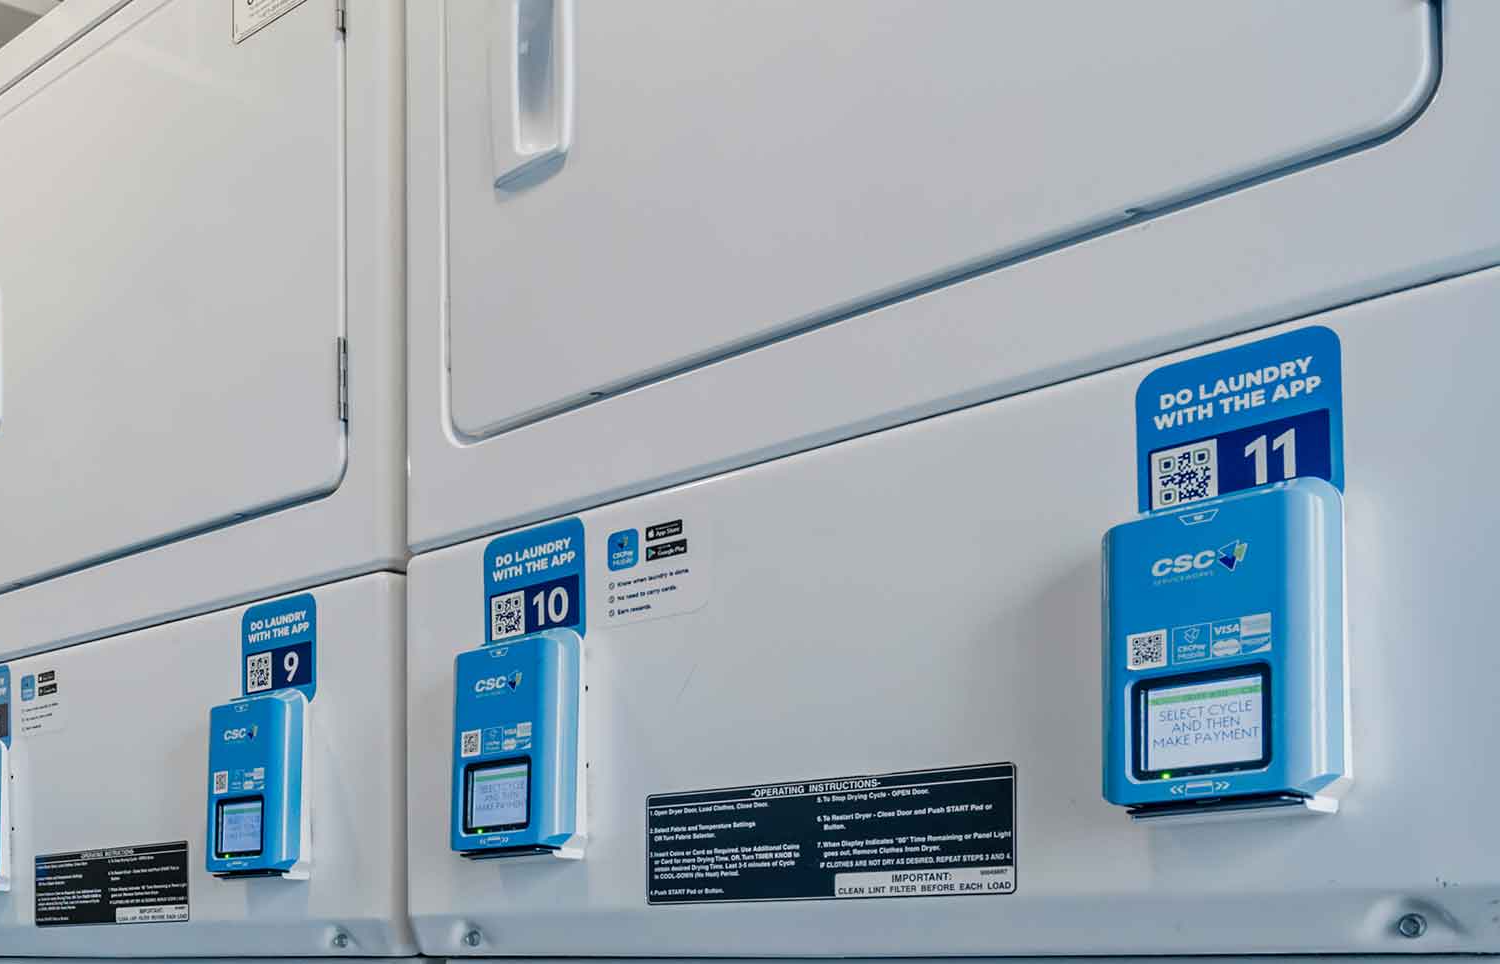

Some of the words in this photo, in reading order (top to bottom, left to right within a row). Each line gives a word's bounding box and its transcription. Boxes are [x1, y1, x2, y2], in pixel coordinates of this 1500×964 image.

[1160, 389, 1192, 410] DO
[1200, 356, 1312, 400] LAUNDRY
[1154, 403, 1213, 430] WITH
[1220, 390, 1265, 414] THE
[1272, 375, 1321, 402] APP
[1244, 428, 1296, 485] 11
[495, 554, 513, 567] DO
[515, 537, 572, 562] LAUNDRY
[492, 564, 522, 583] WITH
[526, 559, 548, 573] THE
[551, 551, 575, 567] APP
[1151, 550, 1216, 577] CSC
[533, 586, 570, 626] 10
[250, 621, 263, 631] DO
[265, 610, 306, 629] LAUNDRY
[1214, 624, 1239, 634] VISA
[248, 632, 270, 644] WITH
[272, 626, 289, 637] THE
[292, 622, 310, 634] APP
[284, 651, 299, 682] 9
[475, 676, 507, 692] CSC
[1159, 705, 1204, 722] SELECT
[1208, 700, 1252, 714] CYCLE
[224, 728, 246, 741] CSC
[1172, 719, 1201, 733] AND
[1206, 716, 1241, 729] THEN
[1153, 734, 1189, 748] MAKE
[1195, 726, 1260, 743] PAYMENT
[838, 887, 864, 895] CLEAN
[868, 886, 885, 894] LINT
[890, 885, 917, 893] FILTER
[921, 883, 955, 892] BEFORE
[960, 882, 983, 890] EACH
[987, 881, 1011, 890] LOAD
